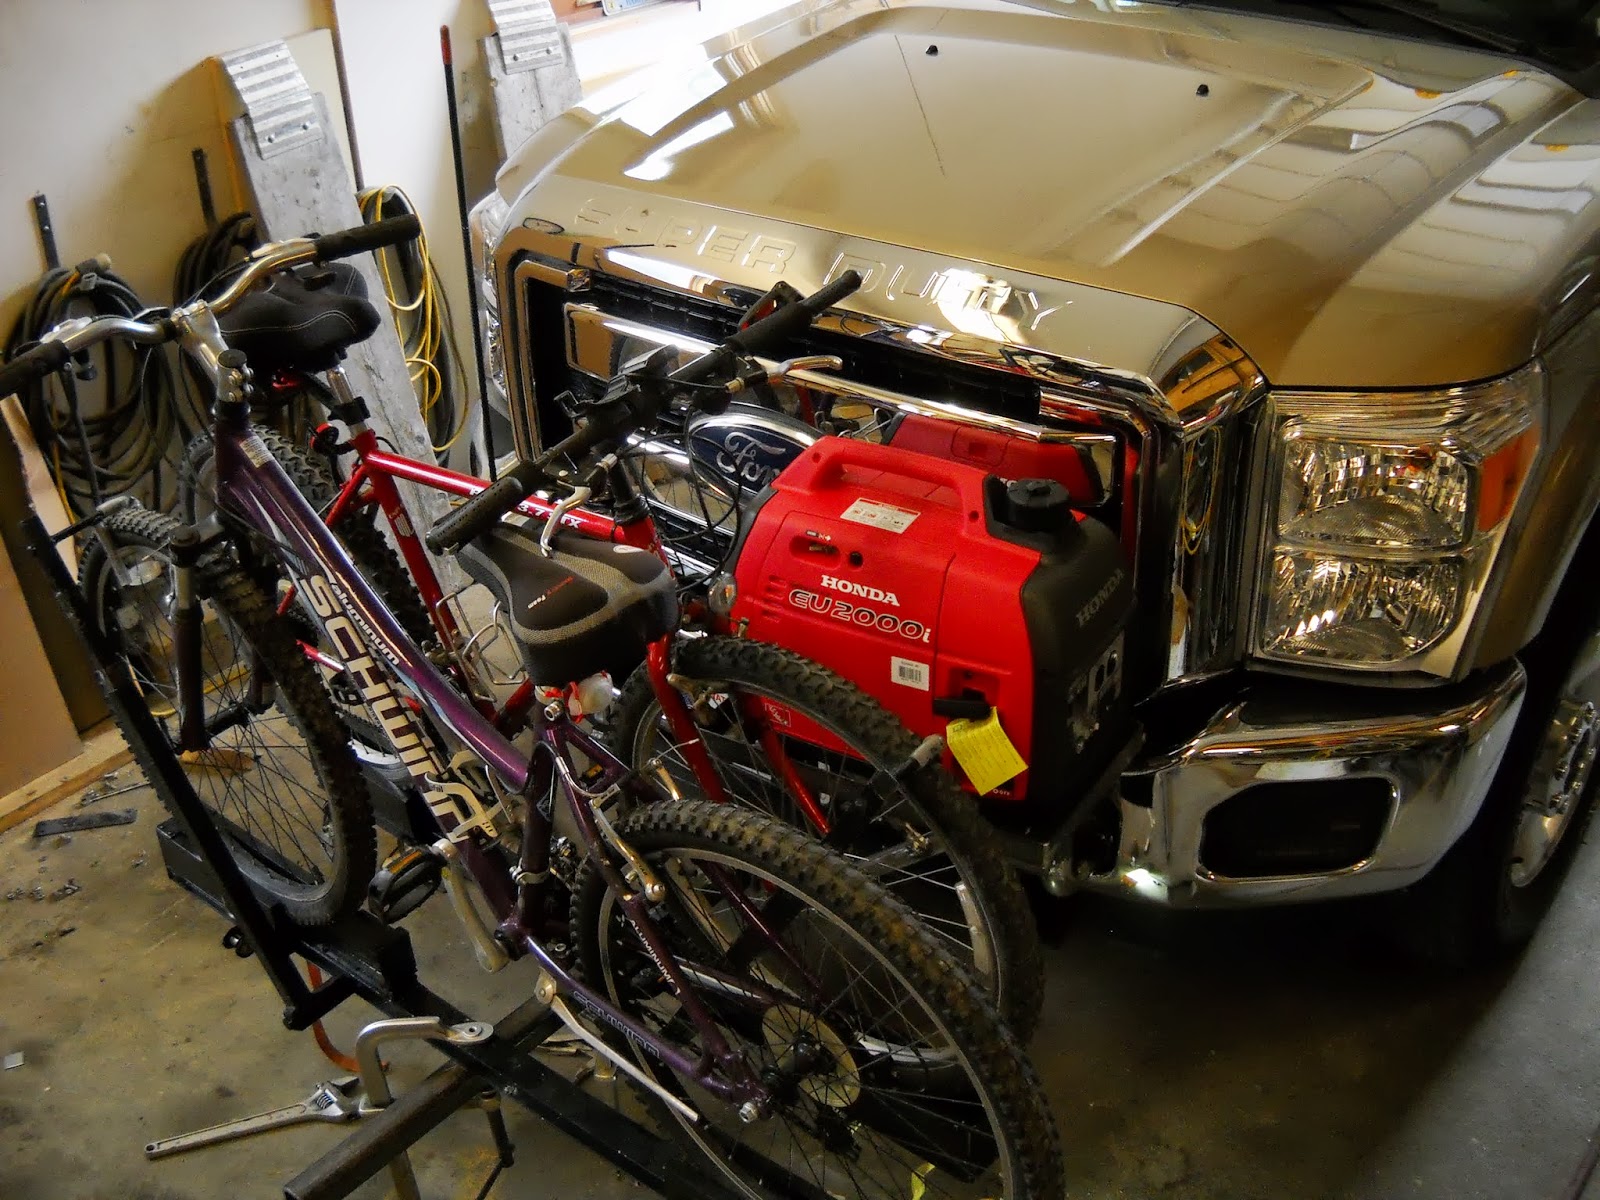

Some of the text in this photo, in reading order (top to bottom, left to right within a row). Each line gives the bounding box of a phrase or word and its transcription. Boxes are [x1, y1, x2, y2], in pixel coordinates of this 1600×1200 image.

[574, 198, 798, 275] SUPER
[716, 431, 786, 486] For
[789, 588, 932, 643] EU2000i
[820, 574, 900, 606] HONDA
[330, 576, 400, 666] aluminum
[627, 919, 674, 983] ALUMINUM
